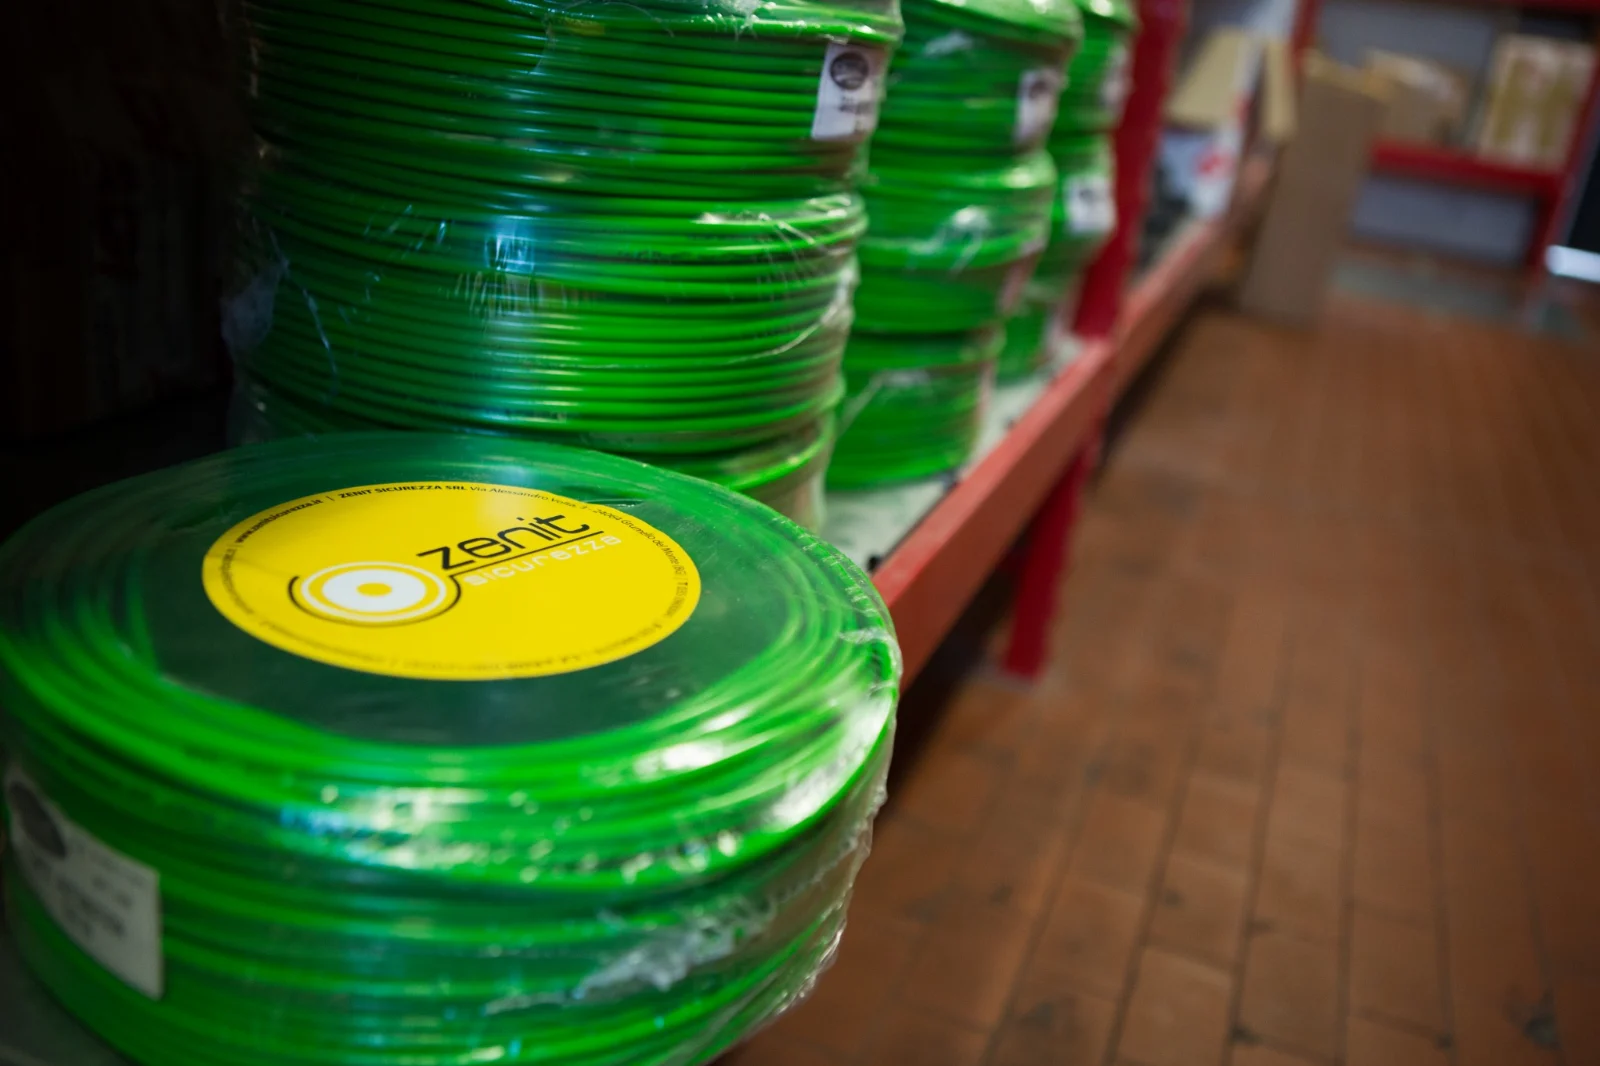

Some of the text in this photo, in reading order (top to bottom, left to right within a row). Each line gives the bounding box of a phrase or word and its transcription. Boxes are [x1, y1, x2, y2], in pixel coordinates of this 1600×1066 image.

[339, 488, 372, 499] ZENIT
[375, 485, 442, 494] SICUREZZA
[490, 487, 549, 501] Alessandro
[416, 515, 590, 570] zenit
[463, 535, 621, 586] sicurezza
